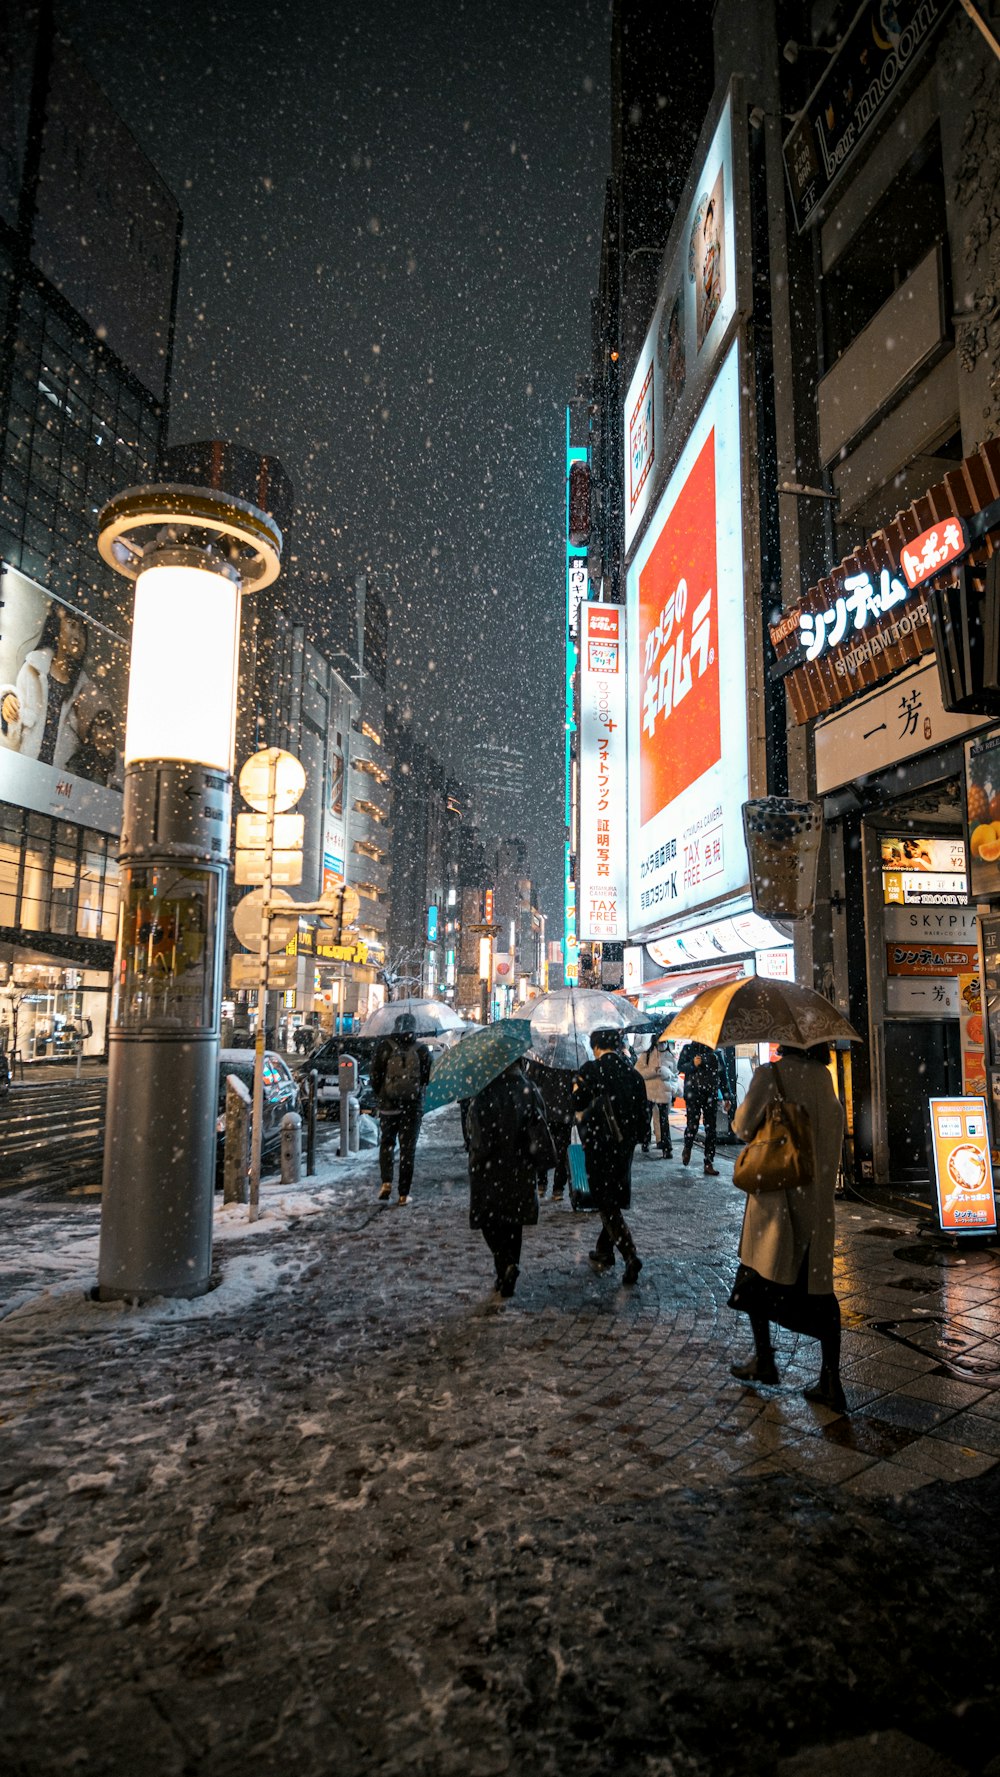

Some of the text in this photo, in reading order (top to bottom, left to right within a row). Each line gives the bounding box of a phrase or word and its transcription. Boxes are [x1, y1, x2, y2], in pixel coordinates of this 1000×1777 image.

[814, 114, 855, 181] bar
[771, 623, 789, 643] TAKE
[643, 588, 713, 738] キタムラ
[834, 627, 892, 676] SINCHAM
[863, 689, 922, 740] 一芳
[596, 819, 611, 877] 証明写真
[683, 839, 700, 868] TAX
[684, 864, 701, 890] FREE
[590, 900, 617, 911] TAX
[920, 893, 958, 905] moon
[589, 911, 617, 922] FREE
[910, 985, 946, 1002] 一芳
